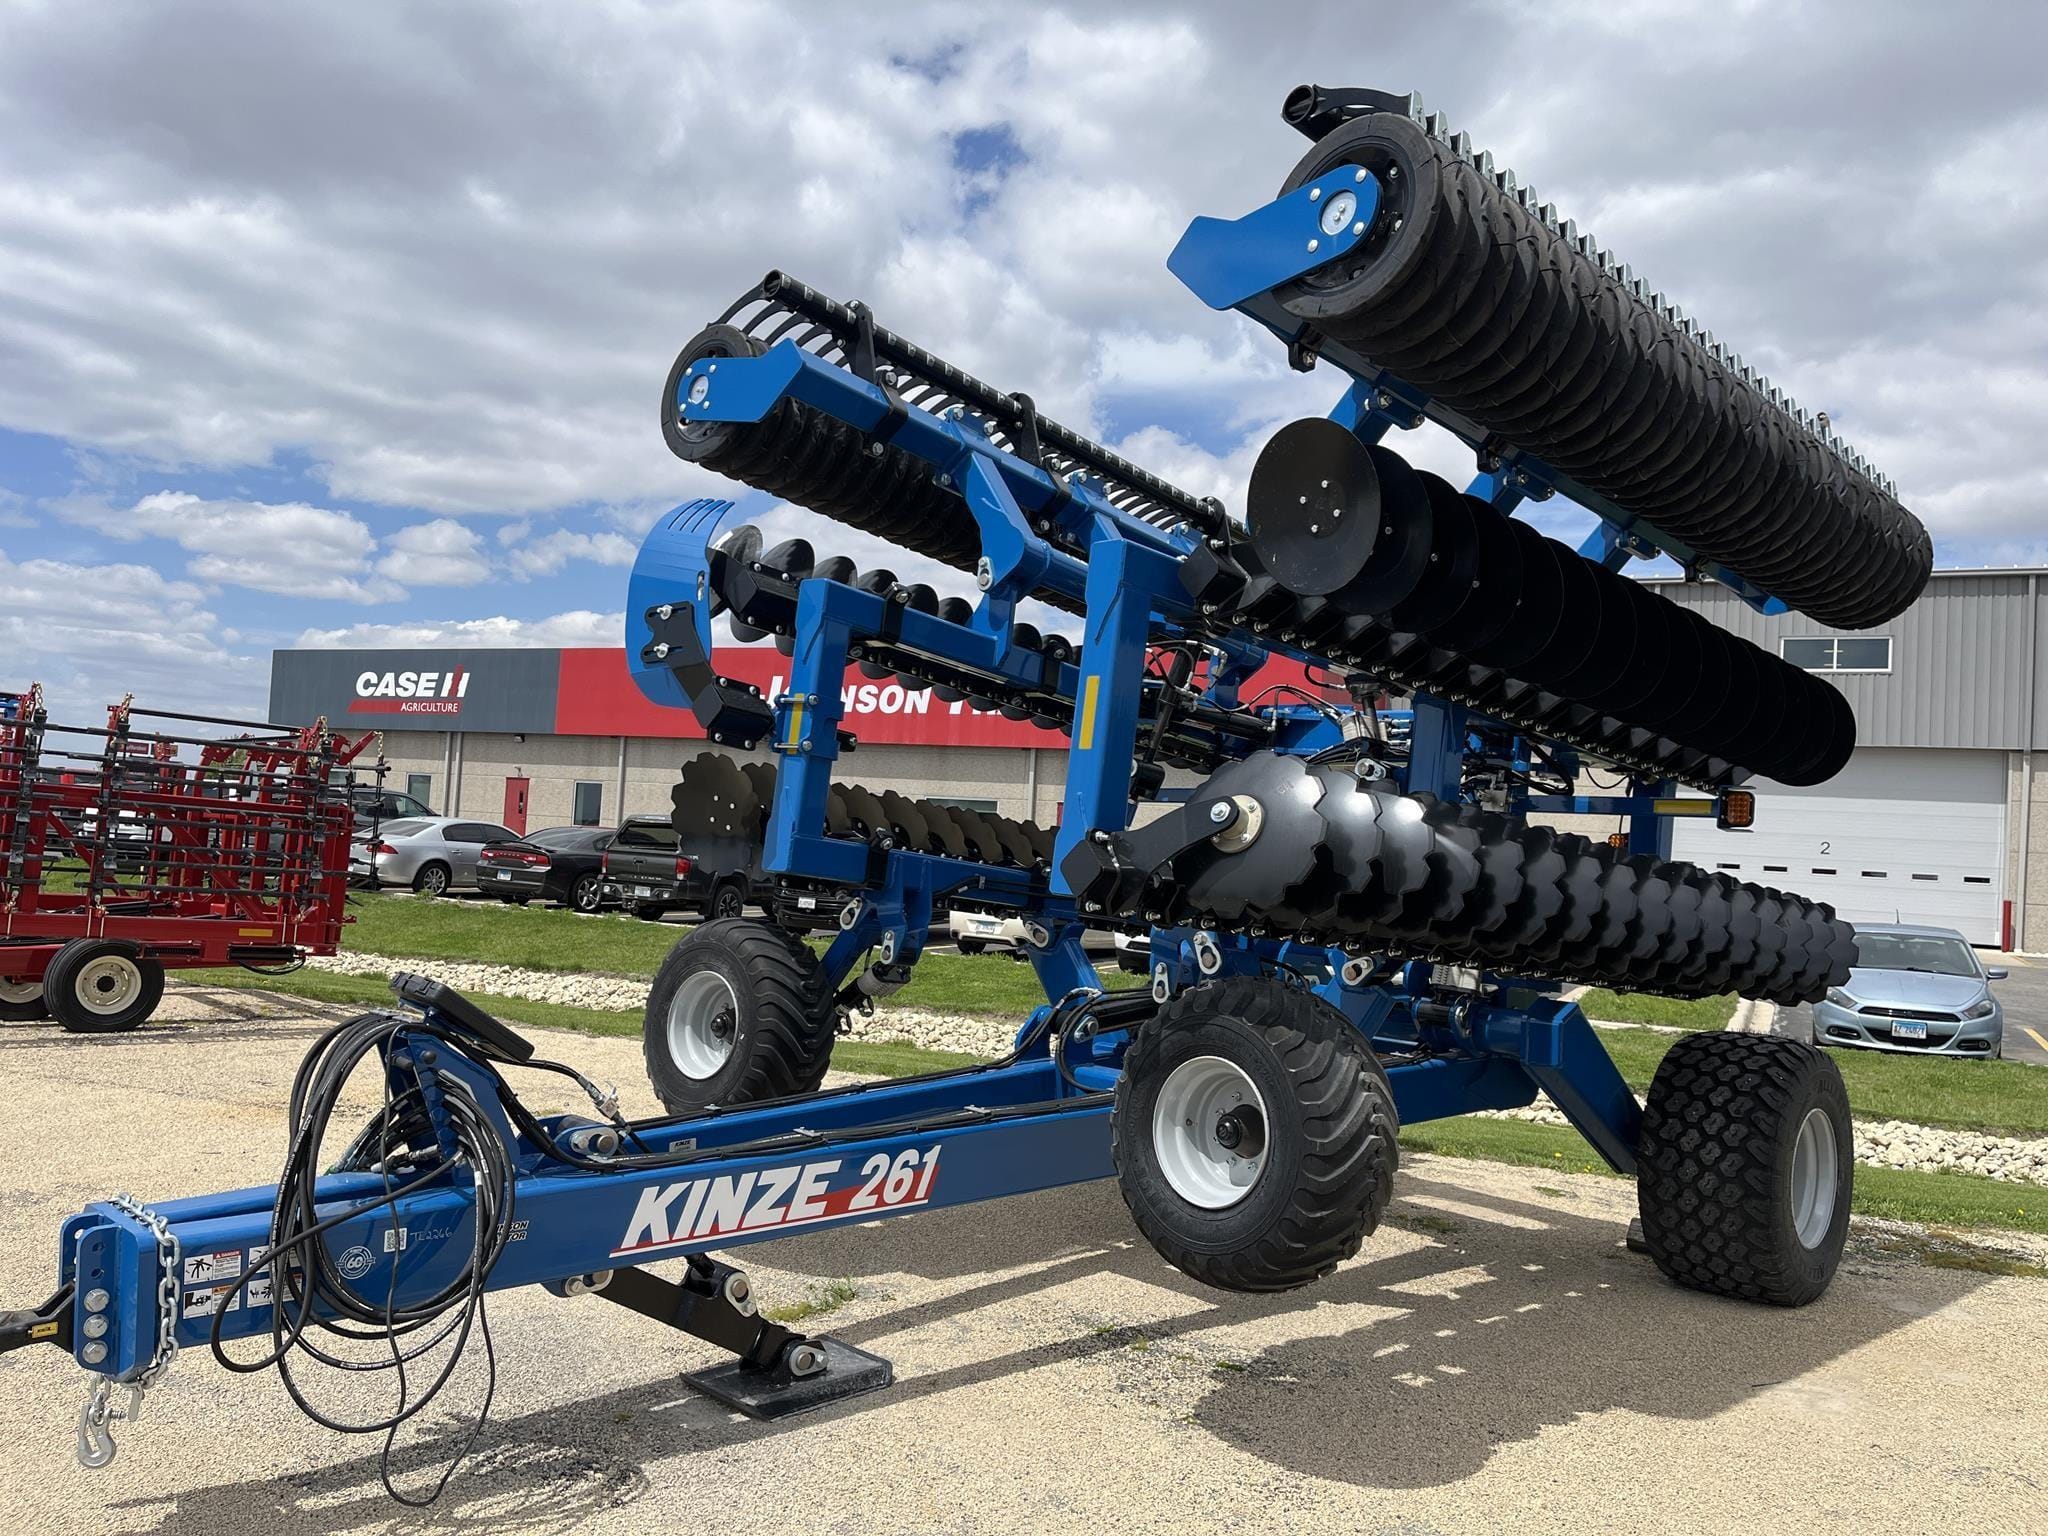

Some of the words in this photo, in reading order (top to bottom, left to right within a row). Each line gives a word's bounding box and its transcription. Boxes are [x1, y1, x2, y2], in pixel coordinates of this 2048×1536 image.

[355, 671, 440, 697] CASE
[400, 702, 459, 713] AGRICULTURE
[1820, 841, 1831, 855] 2
[620, 1159, 843, 1249] KINZE
[848, 1144, 942, 1211] 261
[347, 1256, 364, 1269] 60
